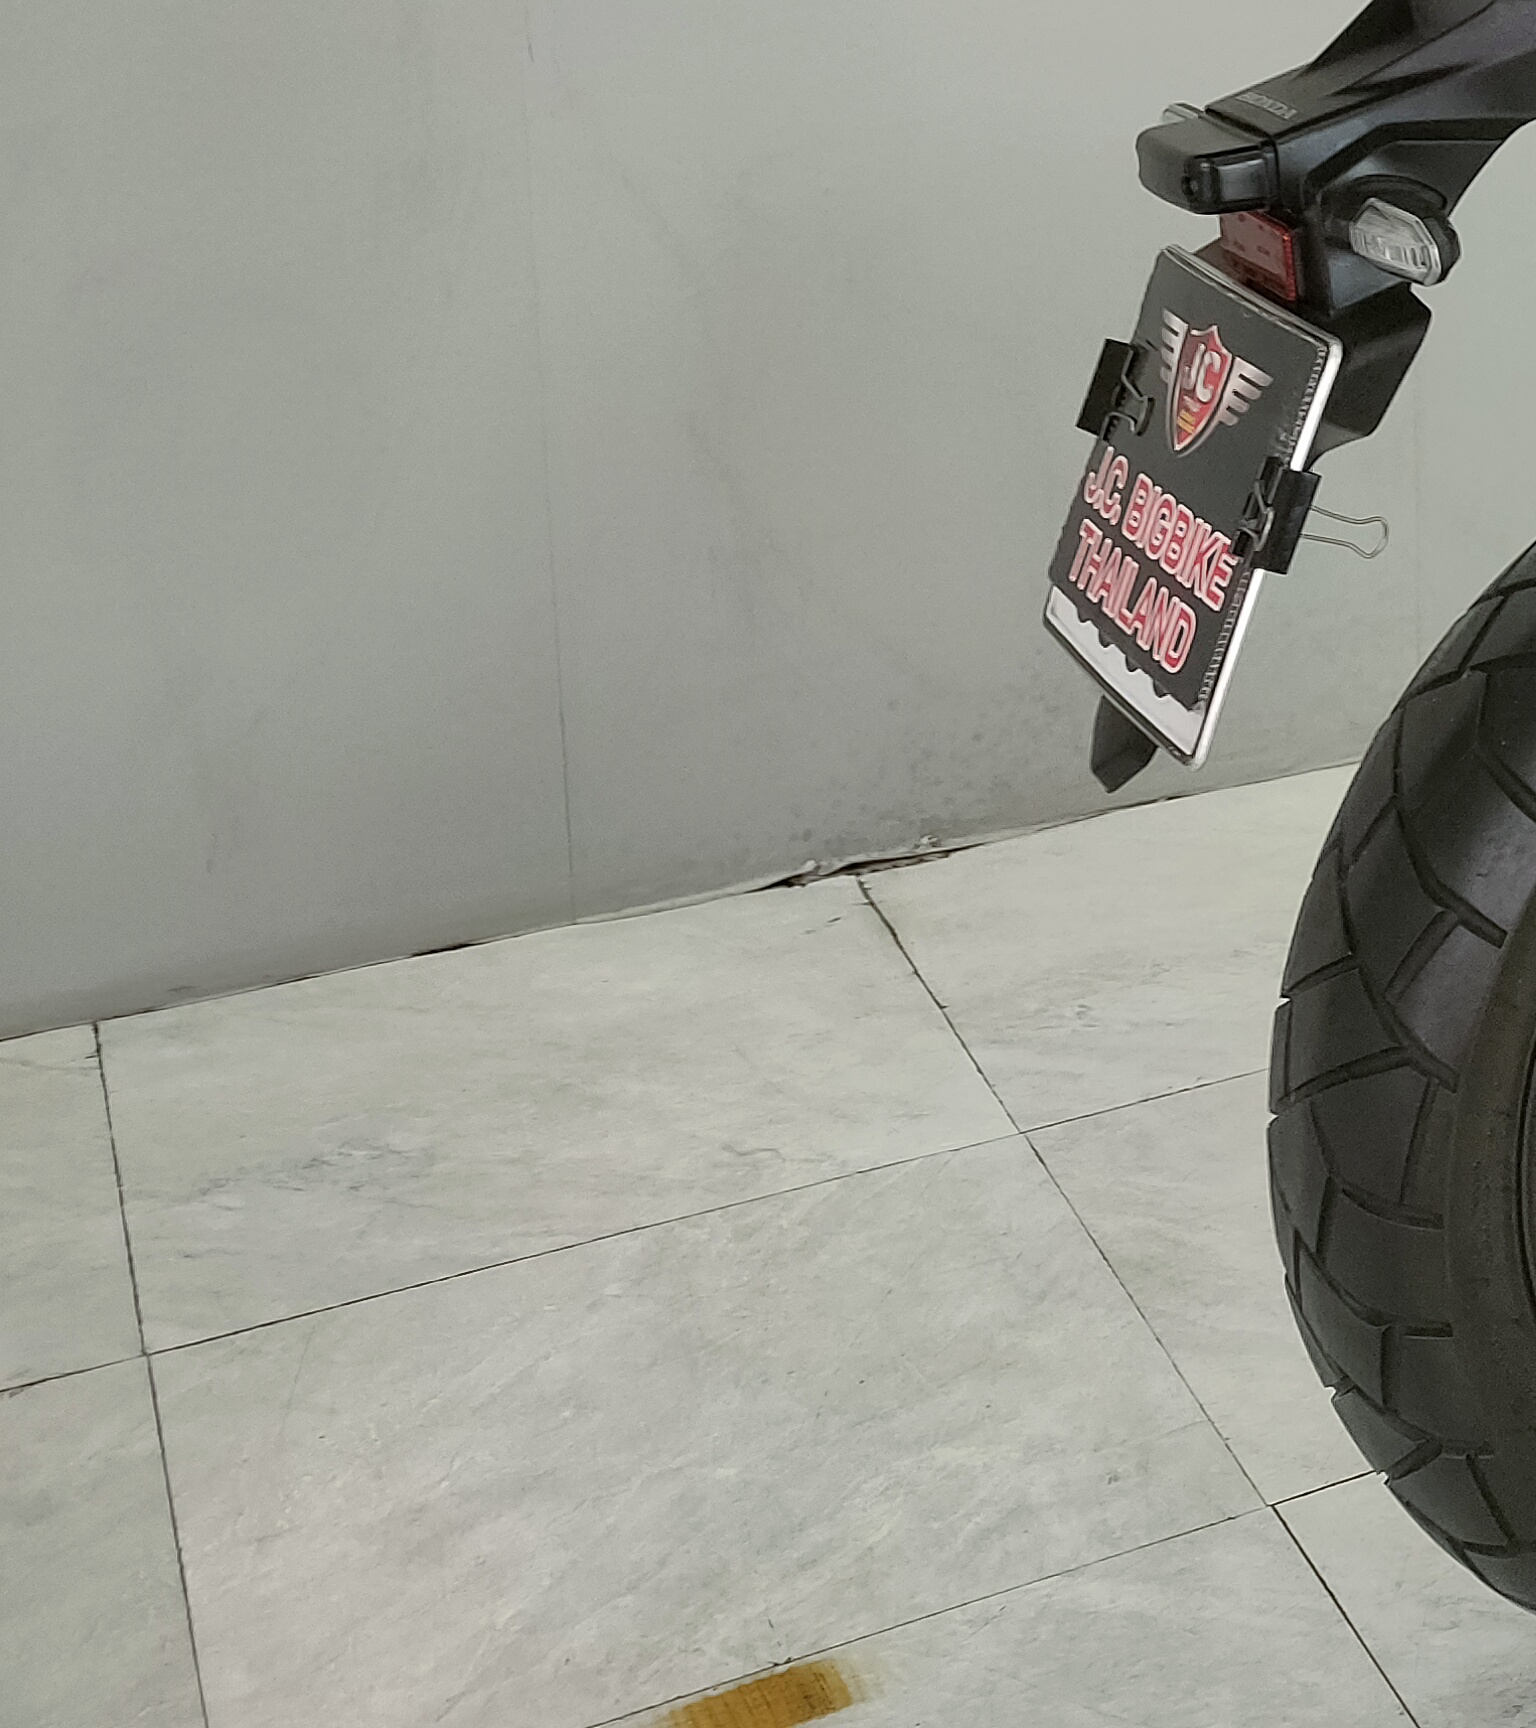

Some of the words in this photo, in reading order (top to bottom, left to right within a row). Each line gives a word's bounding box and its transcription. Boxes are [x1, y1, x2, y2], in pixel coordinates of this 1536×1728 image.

[1182, 342, 1222, 403] JC
[1068, 518, 1198, 674] THAILAND
[1121, 473, 1238, 612] BIGBIKE
